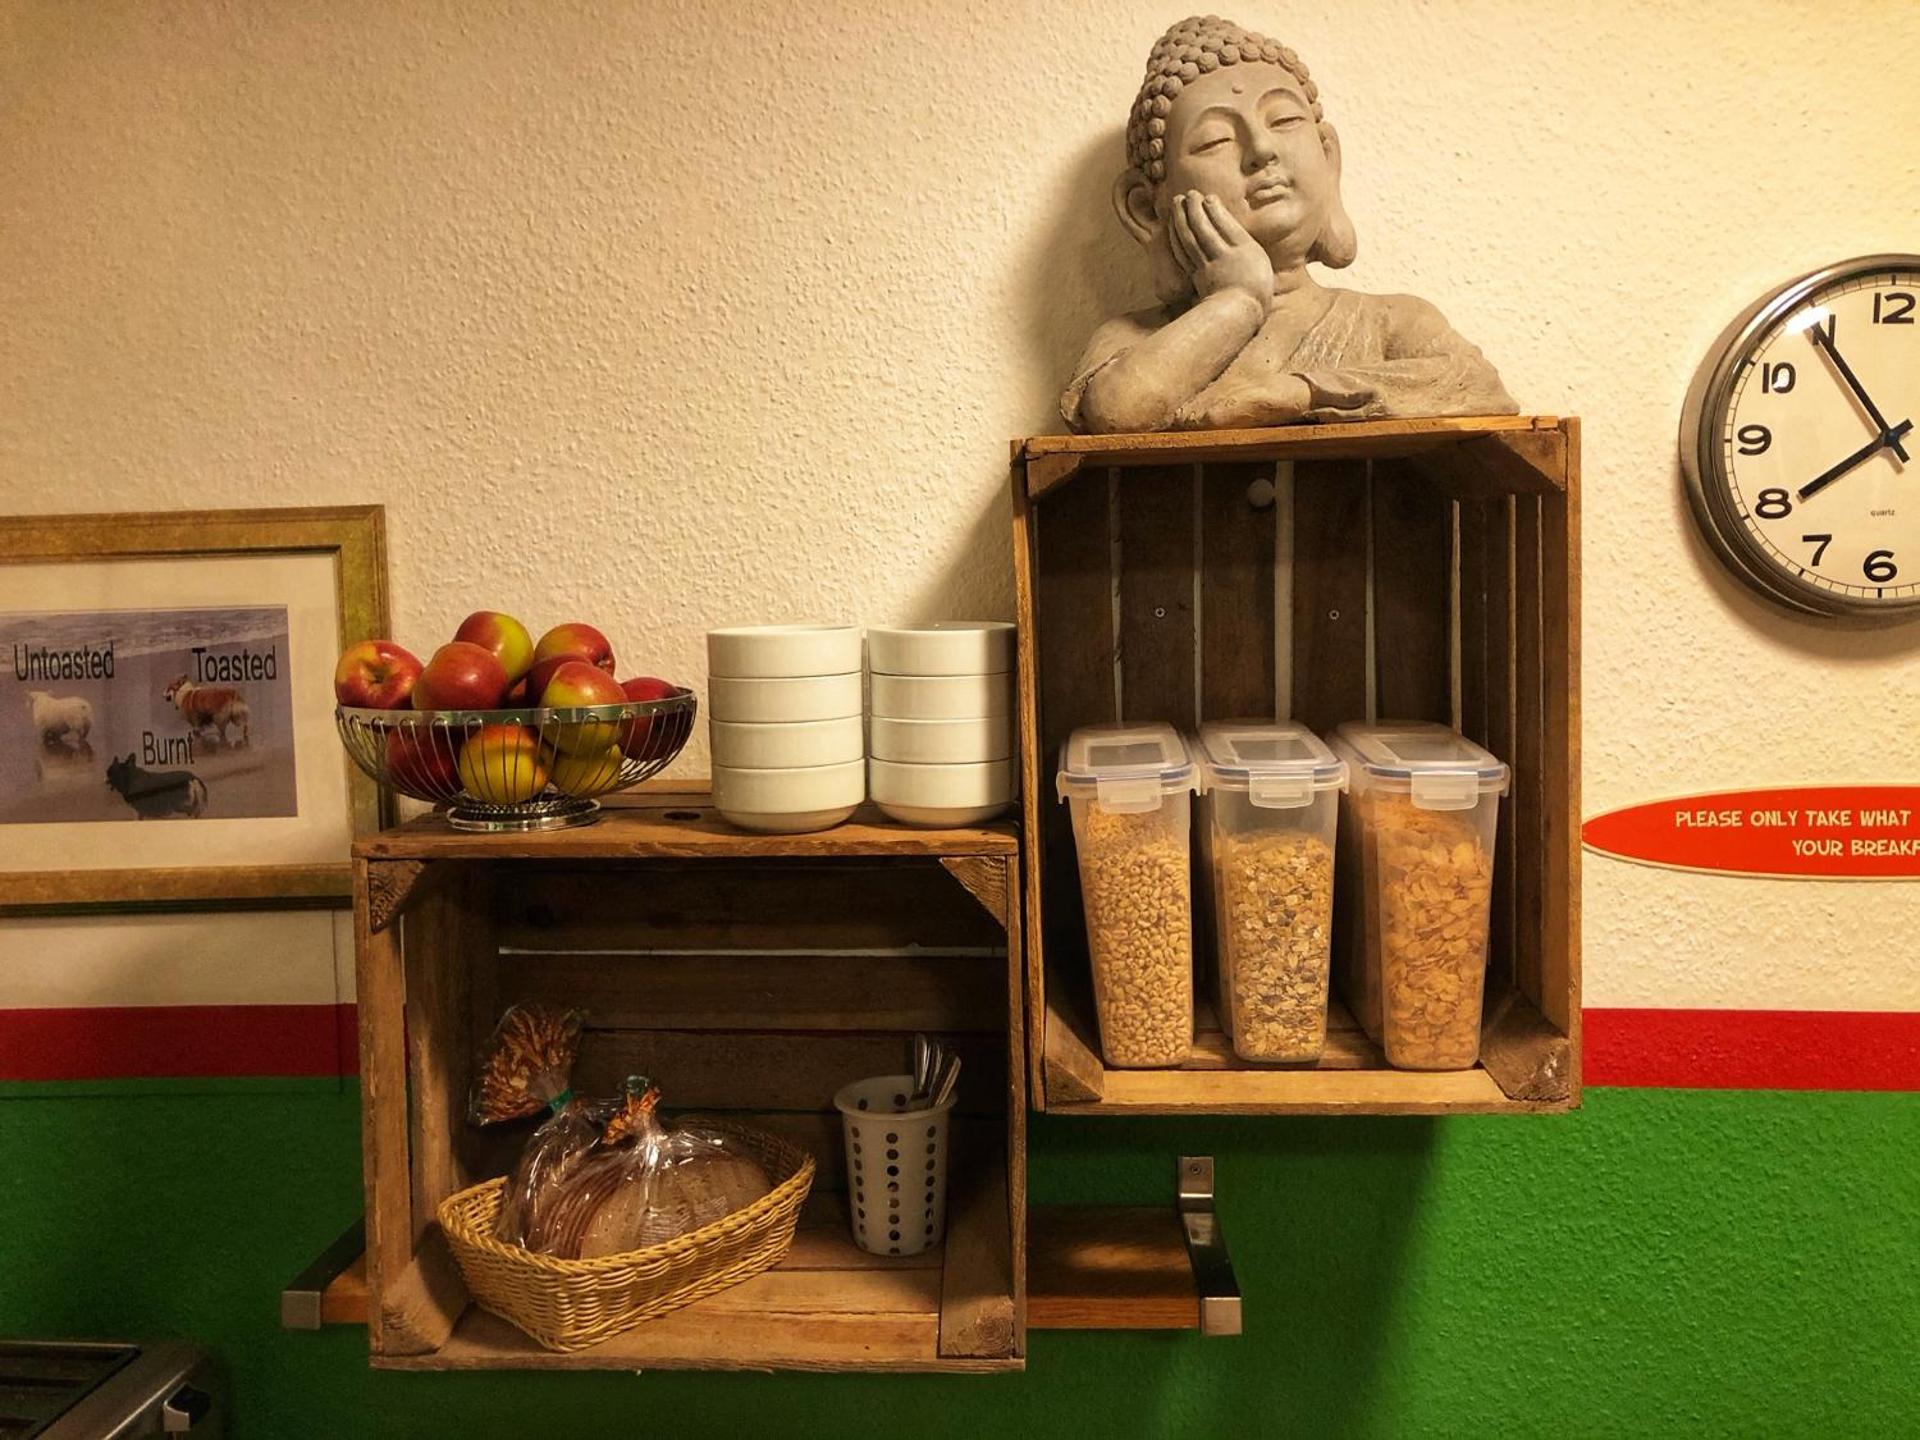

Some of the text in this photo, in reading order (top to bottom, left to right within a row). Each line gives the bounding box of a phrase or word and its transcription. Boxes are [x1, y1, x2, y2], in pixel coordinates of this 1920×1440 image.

[1873, 293, 1917, 324] 12
[1762, 362, 1797, 394] 10
[1737, 424, 1772, 456] 9
[1755, 488, 1792, 519] 8
[1869, 509, 1896, 518] quartz
[1802, 534, 1832, 566] 7
[1863, 550, 1897, 583] 6
[13, 641, 115, 682] Untoasted
[192, 645, 277, 683] Toasted
[142, 731, 195, 766] Burnt
[1675, 809, 1912, 828] PLEASE ONLY TAKE WHAT
[1792, 839, 1843, 857] YOUR
